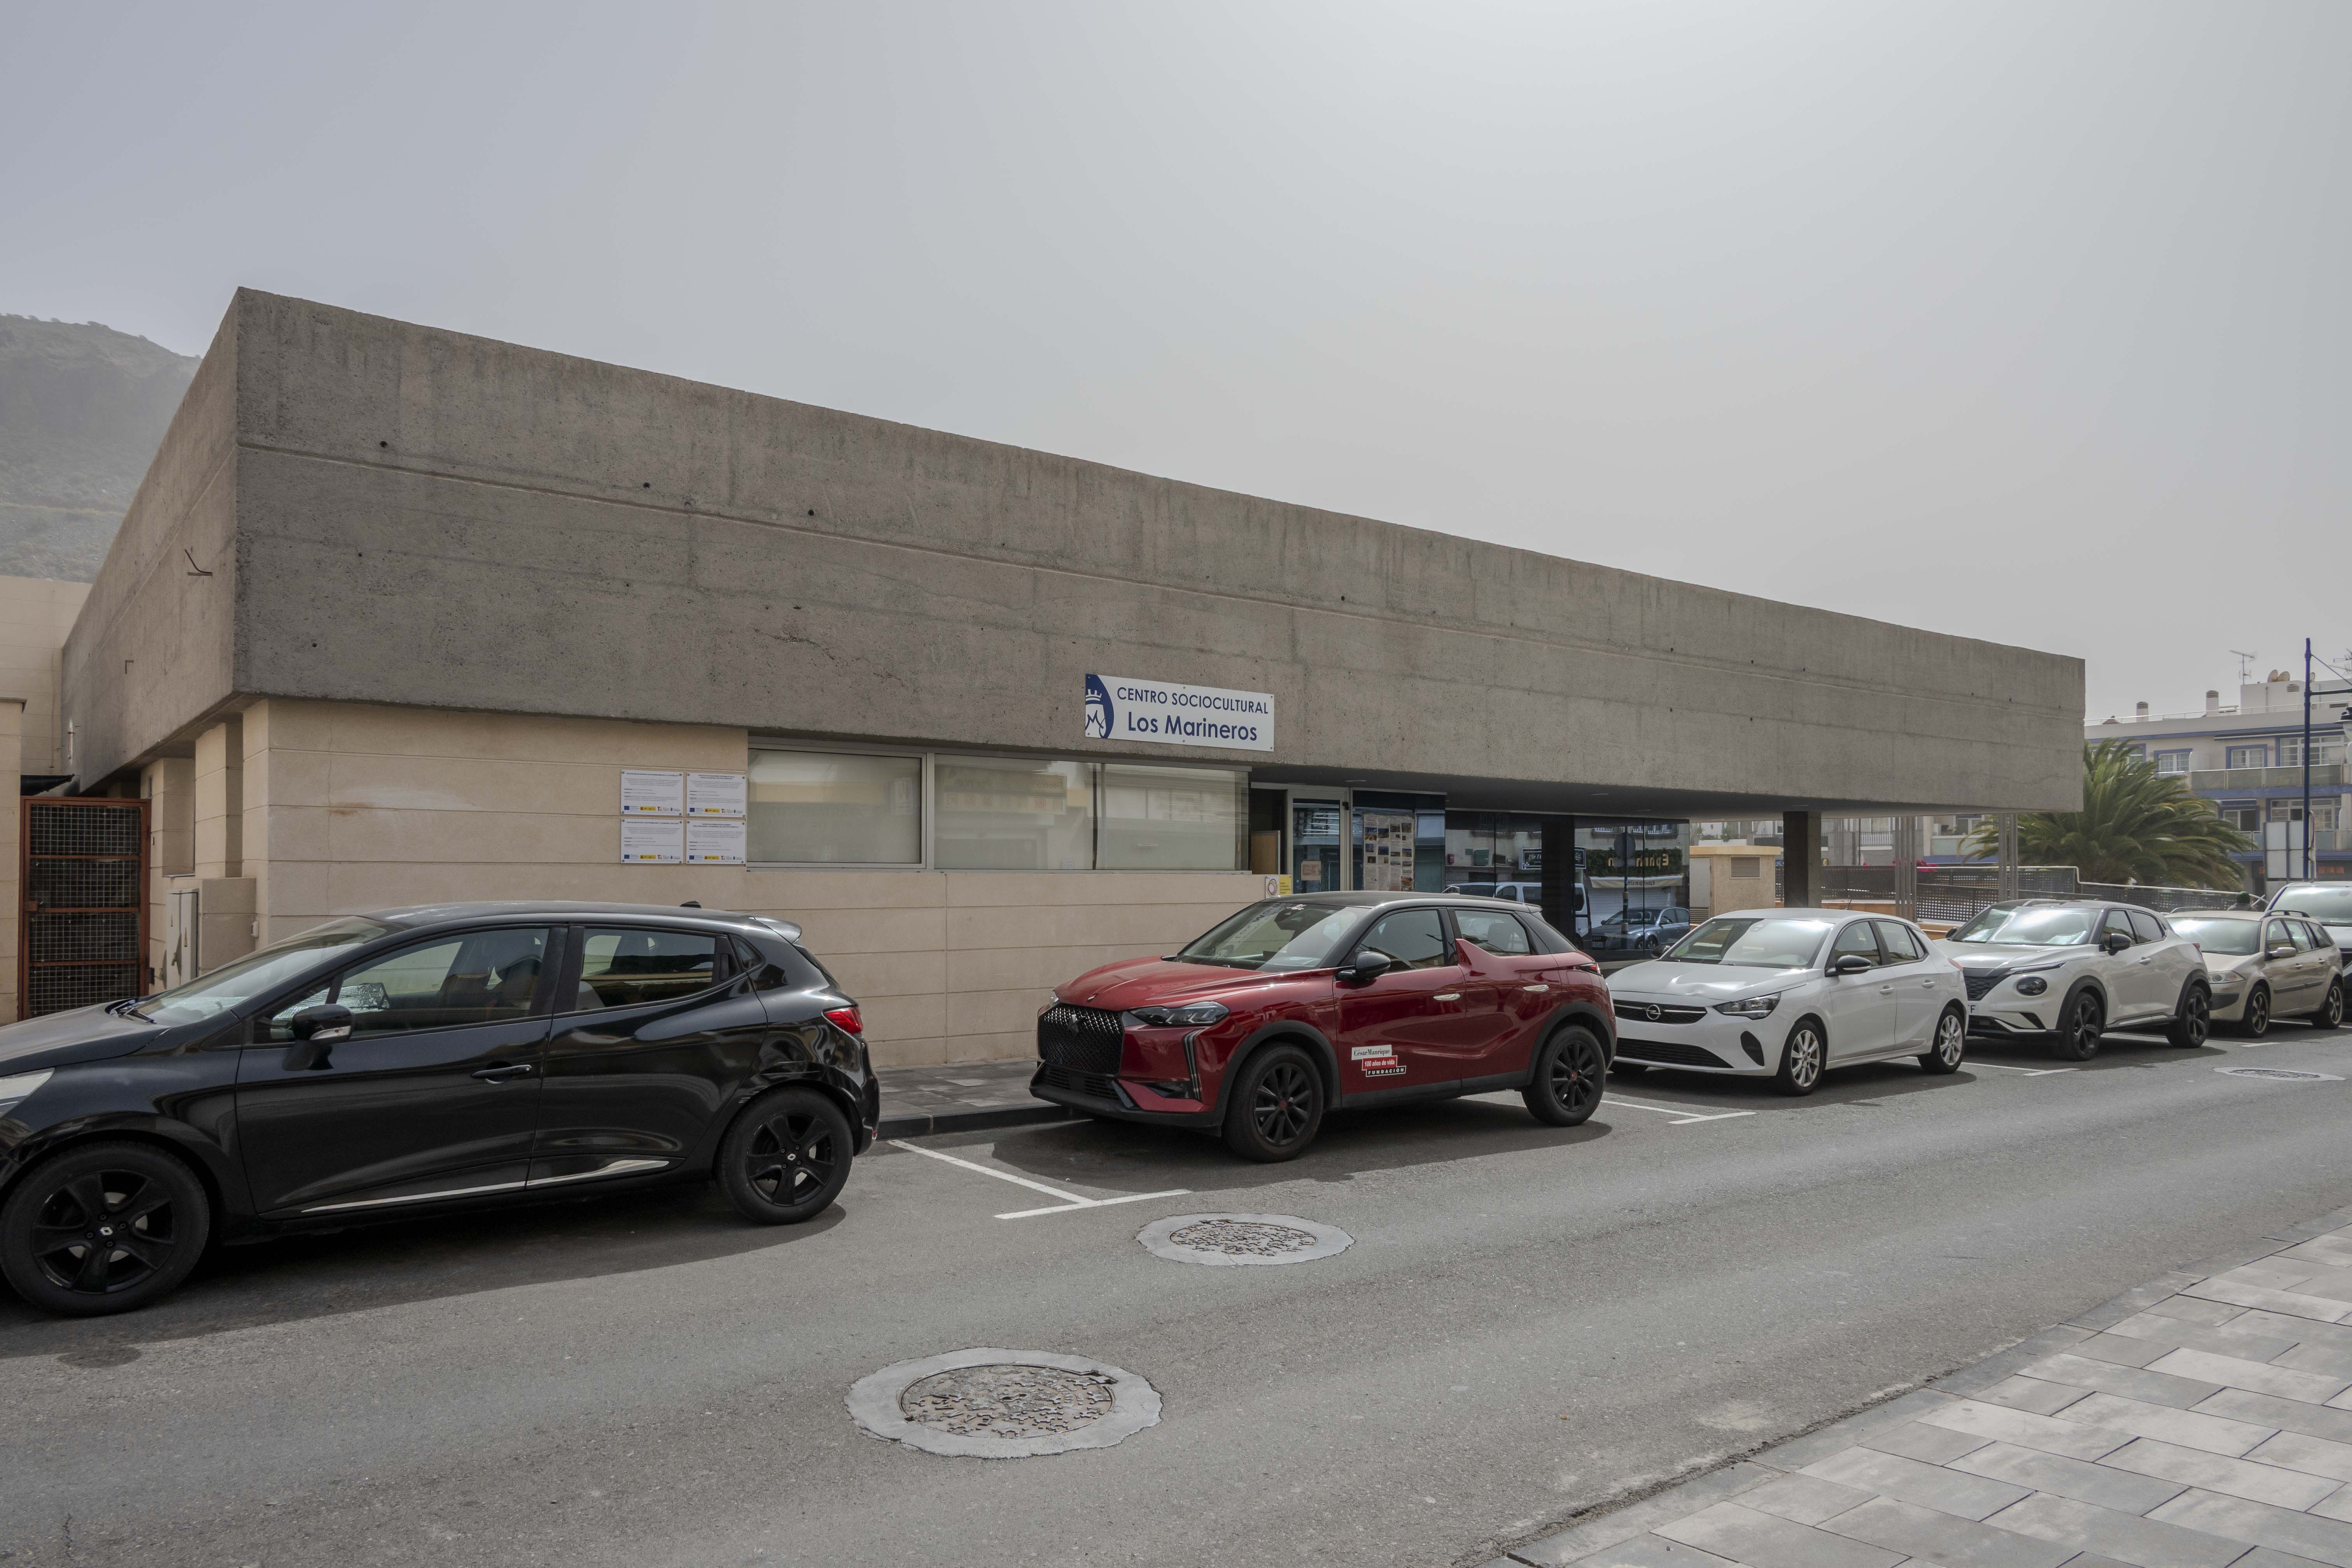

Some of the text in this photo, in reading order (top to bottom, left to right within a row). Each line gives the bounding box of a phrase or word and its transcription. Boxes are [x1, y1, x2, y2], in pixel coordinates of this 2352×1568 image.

[1117, 686, 1268, 714] CENTRO SOCIOCULTURAL
[1128, 712, 1257, 741] Los Marineros
